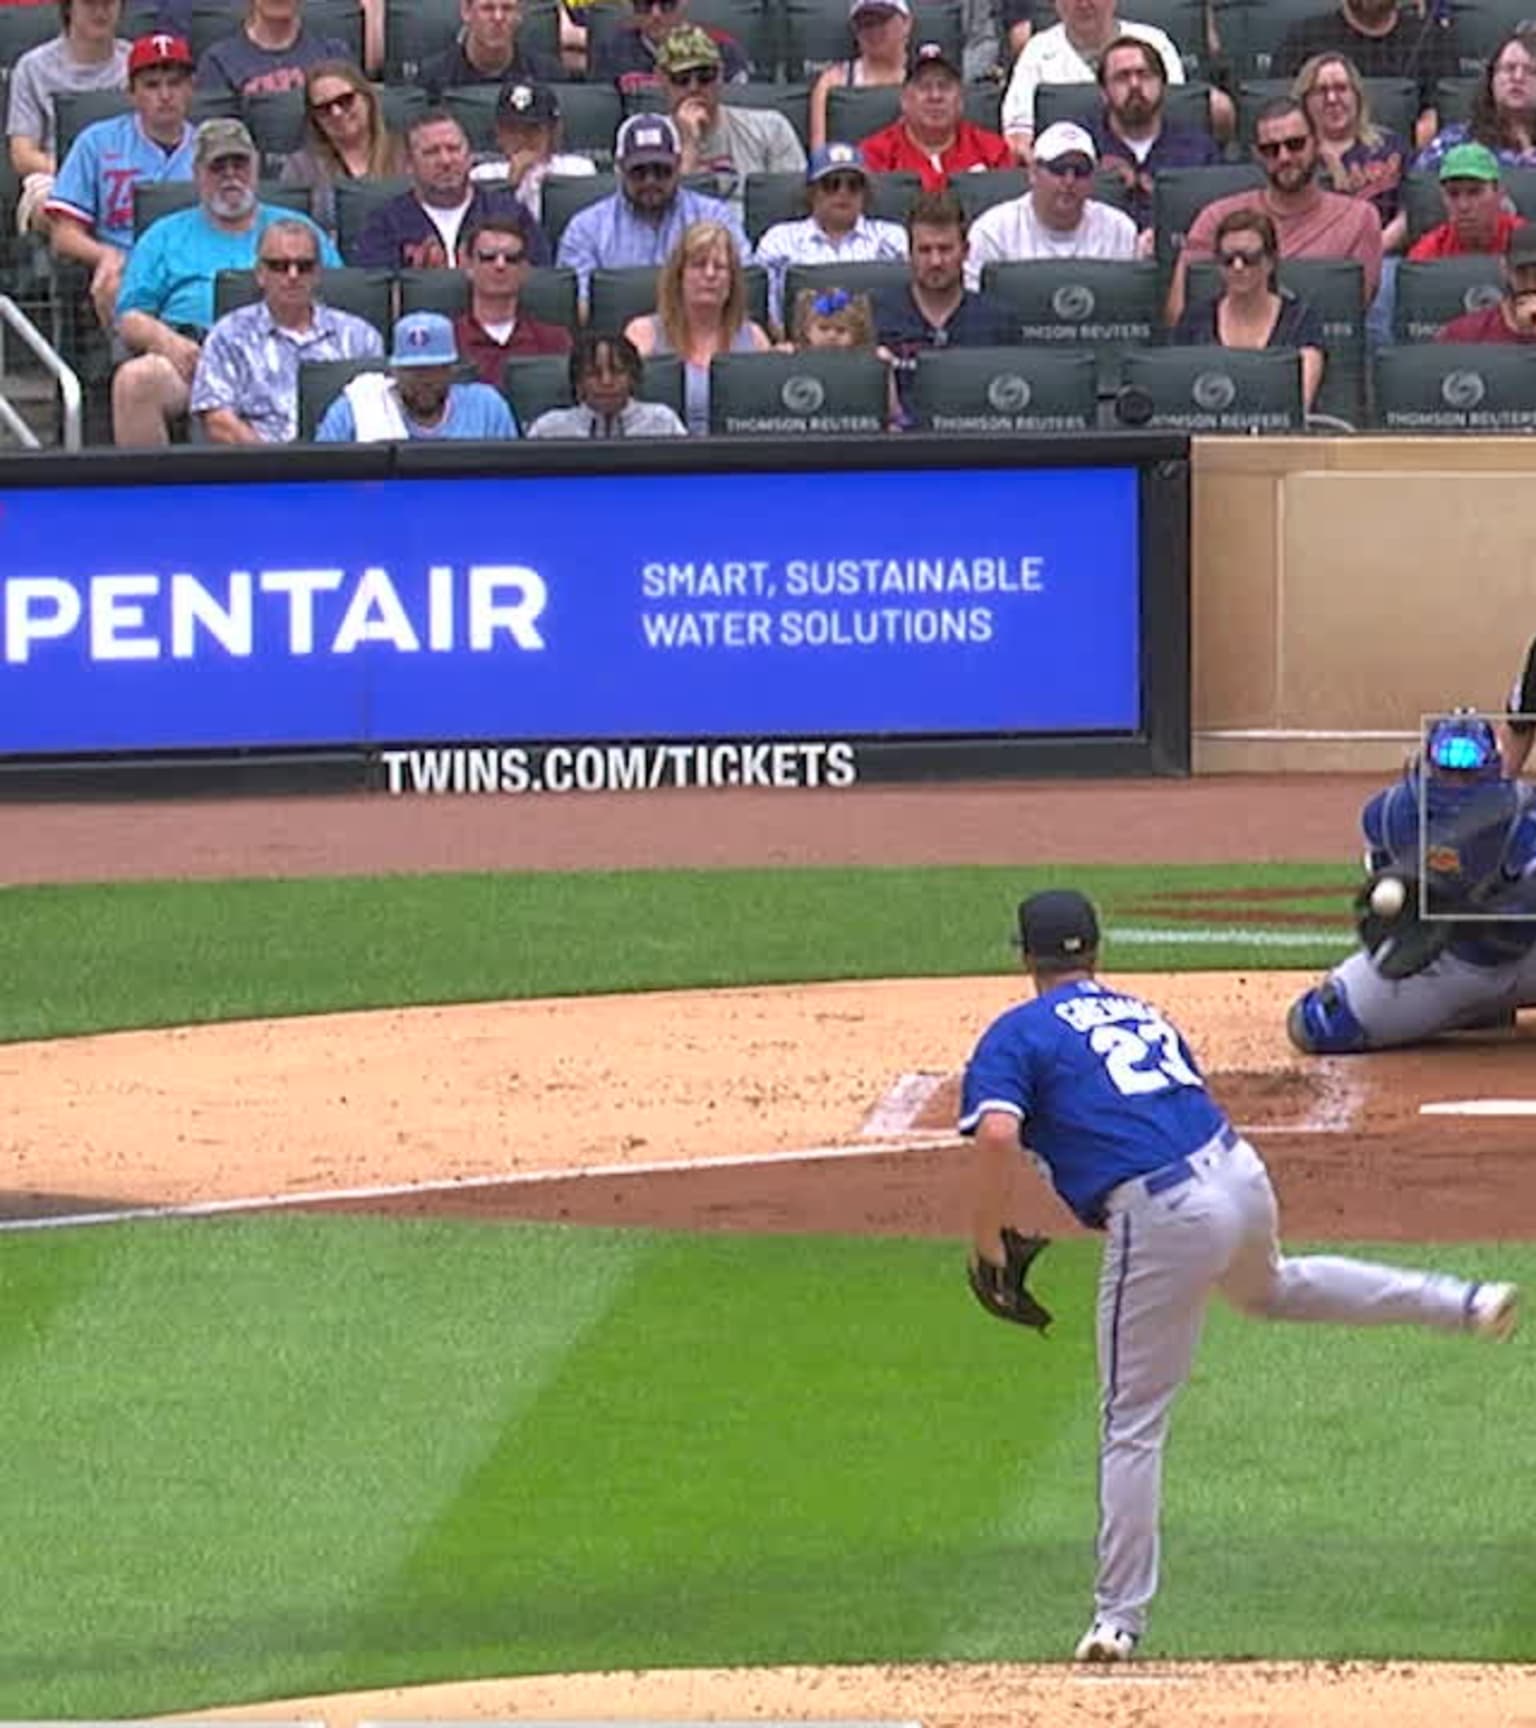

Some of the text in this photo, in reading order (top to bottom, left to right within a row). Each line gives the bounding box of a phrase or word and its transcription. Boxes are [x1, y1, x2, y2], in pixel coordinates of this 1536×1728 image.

[152, 34, 173, 57] T
[1080, 325, 1151, 338] REUTERS
[726, 417, 881, 432] THOMSON REUTERS
[932, 416, 1086, 431] THOMSON REUTERS
[1221, 414, 1291, 427] REUTERS
[1386, 411, 1466, 426] THOMSON
[642, 556, 1044, 598] SMART, SUSTAINABLE
[5, 564, 548, 663] PENTAIR
[642, 607, 994, 648] WATER SOLUTIONS
[382, 743, 856, 795] TWINS.COM/TICKETS
